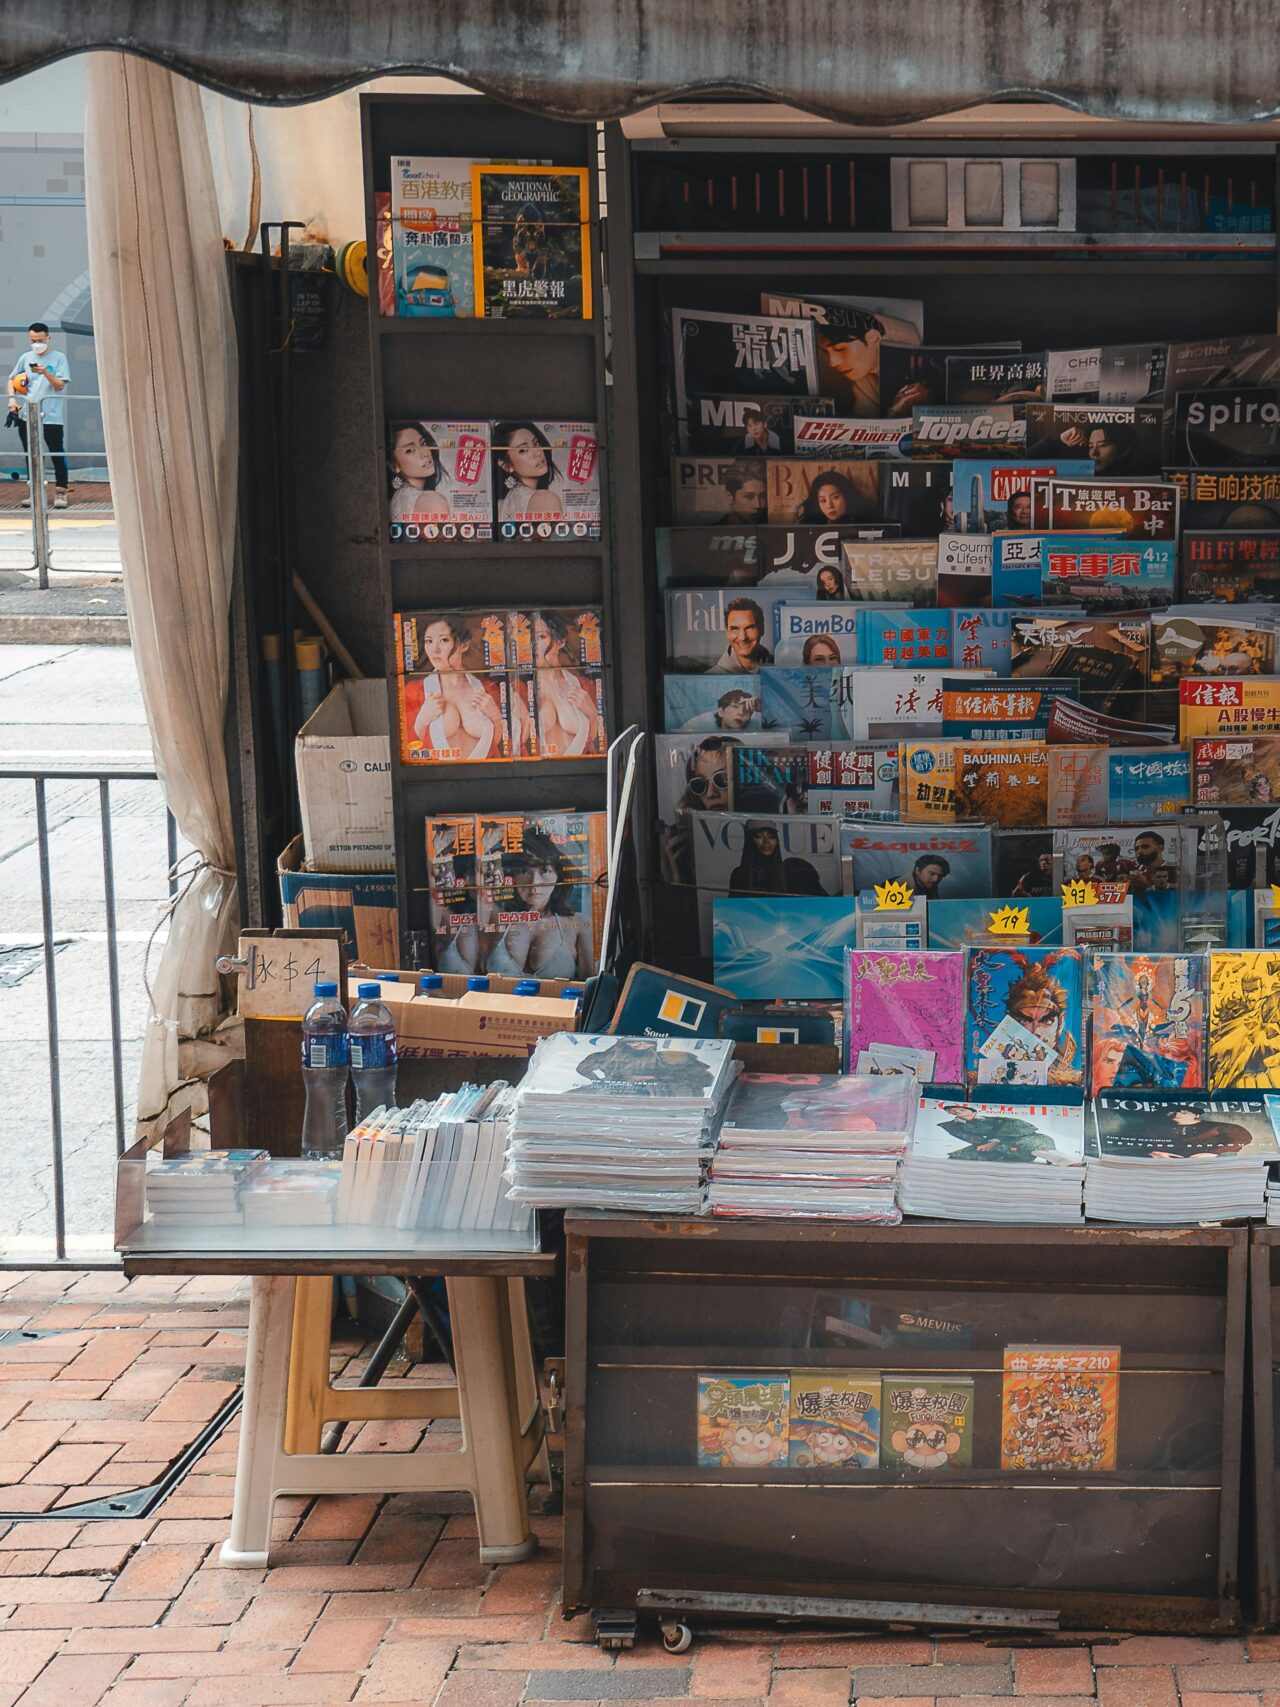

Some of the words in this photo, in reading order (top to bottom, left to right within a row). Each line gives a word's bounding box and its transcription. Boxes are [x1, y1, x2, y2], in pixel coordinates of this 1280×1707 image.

[508, 182, 554, 192] NATIONAL
[501, 190, 560, 202] GEOGRAPHIC
[404, 231, 474, 248] 奔赴廣闊天
[502, 280, 566, 299] 黑虎警報
[970, 363, 1047, 383] 世界高級
[1053, 411, 1135, 425] MINGWATCH
[1055, 487, 1125, 512] Travel
[1132, 489, 1173, 512] Bar
[1077, 489, 1116, 501] 旅遊吧
[1143, 514, 1166, 537] 中
[1048, 553, 1141, 578] 軍事家
[851, 568, 938, 582] LEISU
[883, 628, 949, 643] 中國軍力
[1127, 631, 1143, 644] 233
[883, 645, 949, 661] 超越美國
[1191, 683, 1240, 706] 信報
[838, 750, 873, 771] 健康
[963, 753, 1022, 765] BAUHINIA
[840, 771, 873, 786] 創富
[697, 818, 835, 856] VOUE
[850, 836, 981, 854] Esquire
[329, 844, 352, 852] SETTON
[353, 844, 384, 852] PISTACHIO
[884, 890, 906, 905] 102
[1070, 888, 1086, 904] 93
[499, 910, 541, 923] 凹凸有致
[1000, 916, 1019, 929] 79
[283, 951, 326, 992] $4
[914, 1316, 962, 1333] MEVIUS
[1030, 1355, 1088, 1380] 老夫子
[1088, 1356, 1111, 1370] 210
[797, 1390, 873, 1415] 爆笑校園
[891, 1389, 968, 1414] 爆笑校園
[955, 1417, 964, 1425] 11
